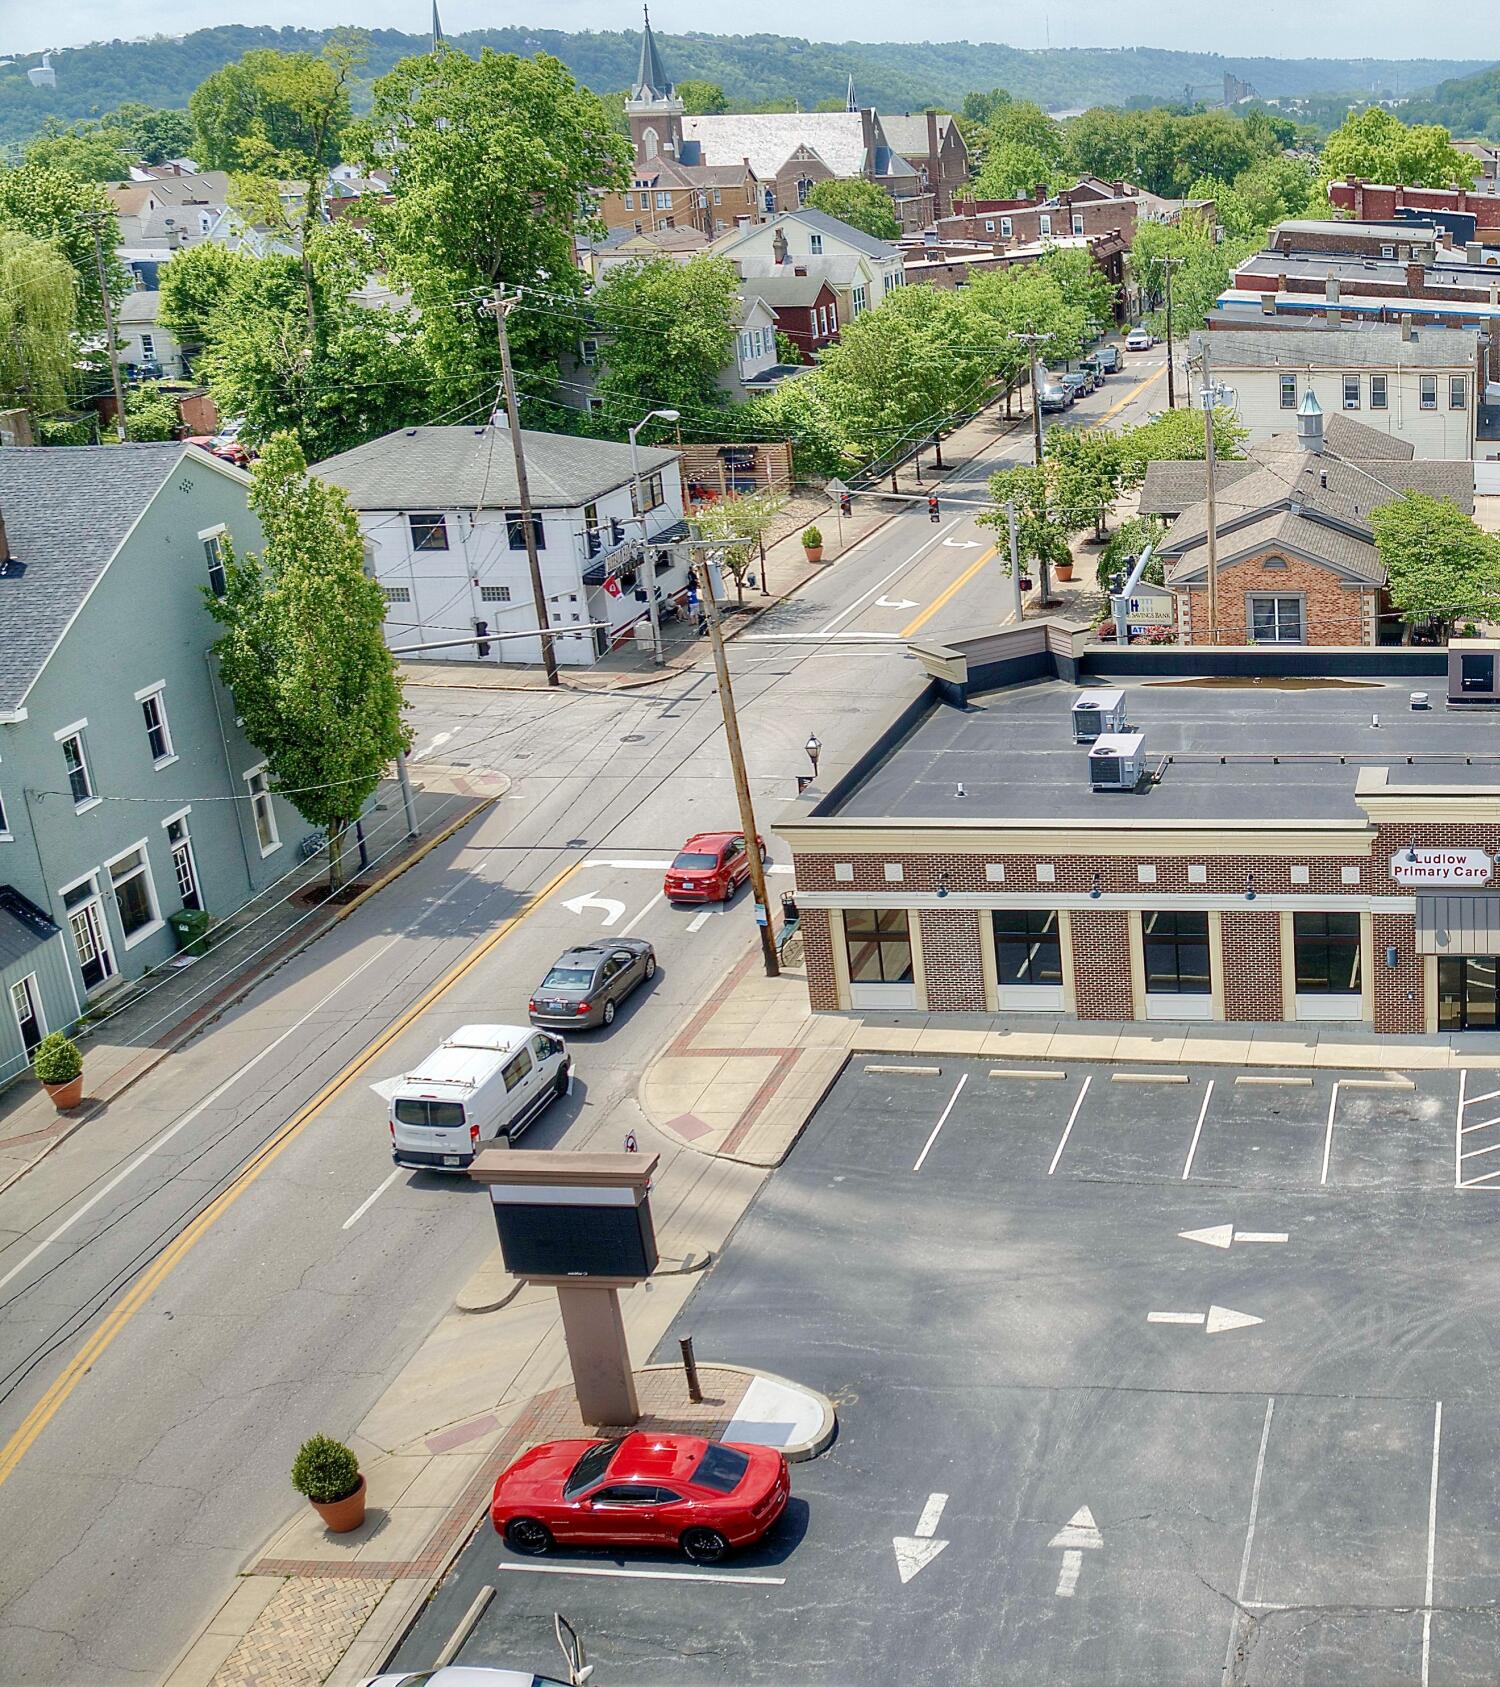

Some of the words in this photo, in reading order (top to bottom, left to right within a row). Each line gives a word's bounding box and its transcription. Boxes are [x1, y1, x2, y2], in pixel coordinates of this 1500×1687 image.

[1415, 854, 1467, 865] Ludlow
[1394, 866, 1449, 878] Primary
[1453, 866, 1488, 877] Care
